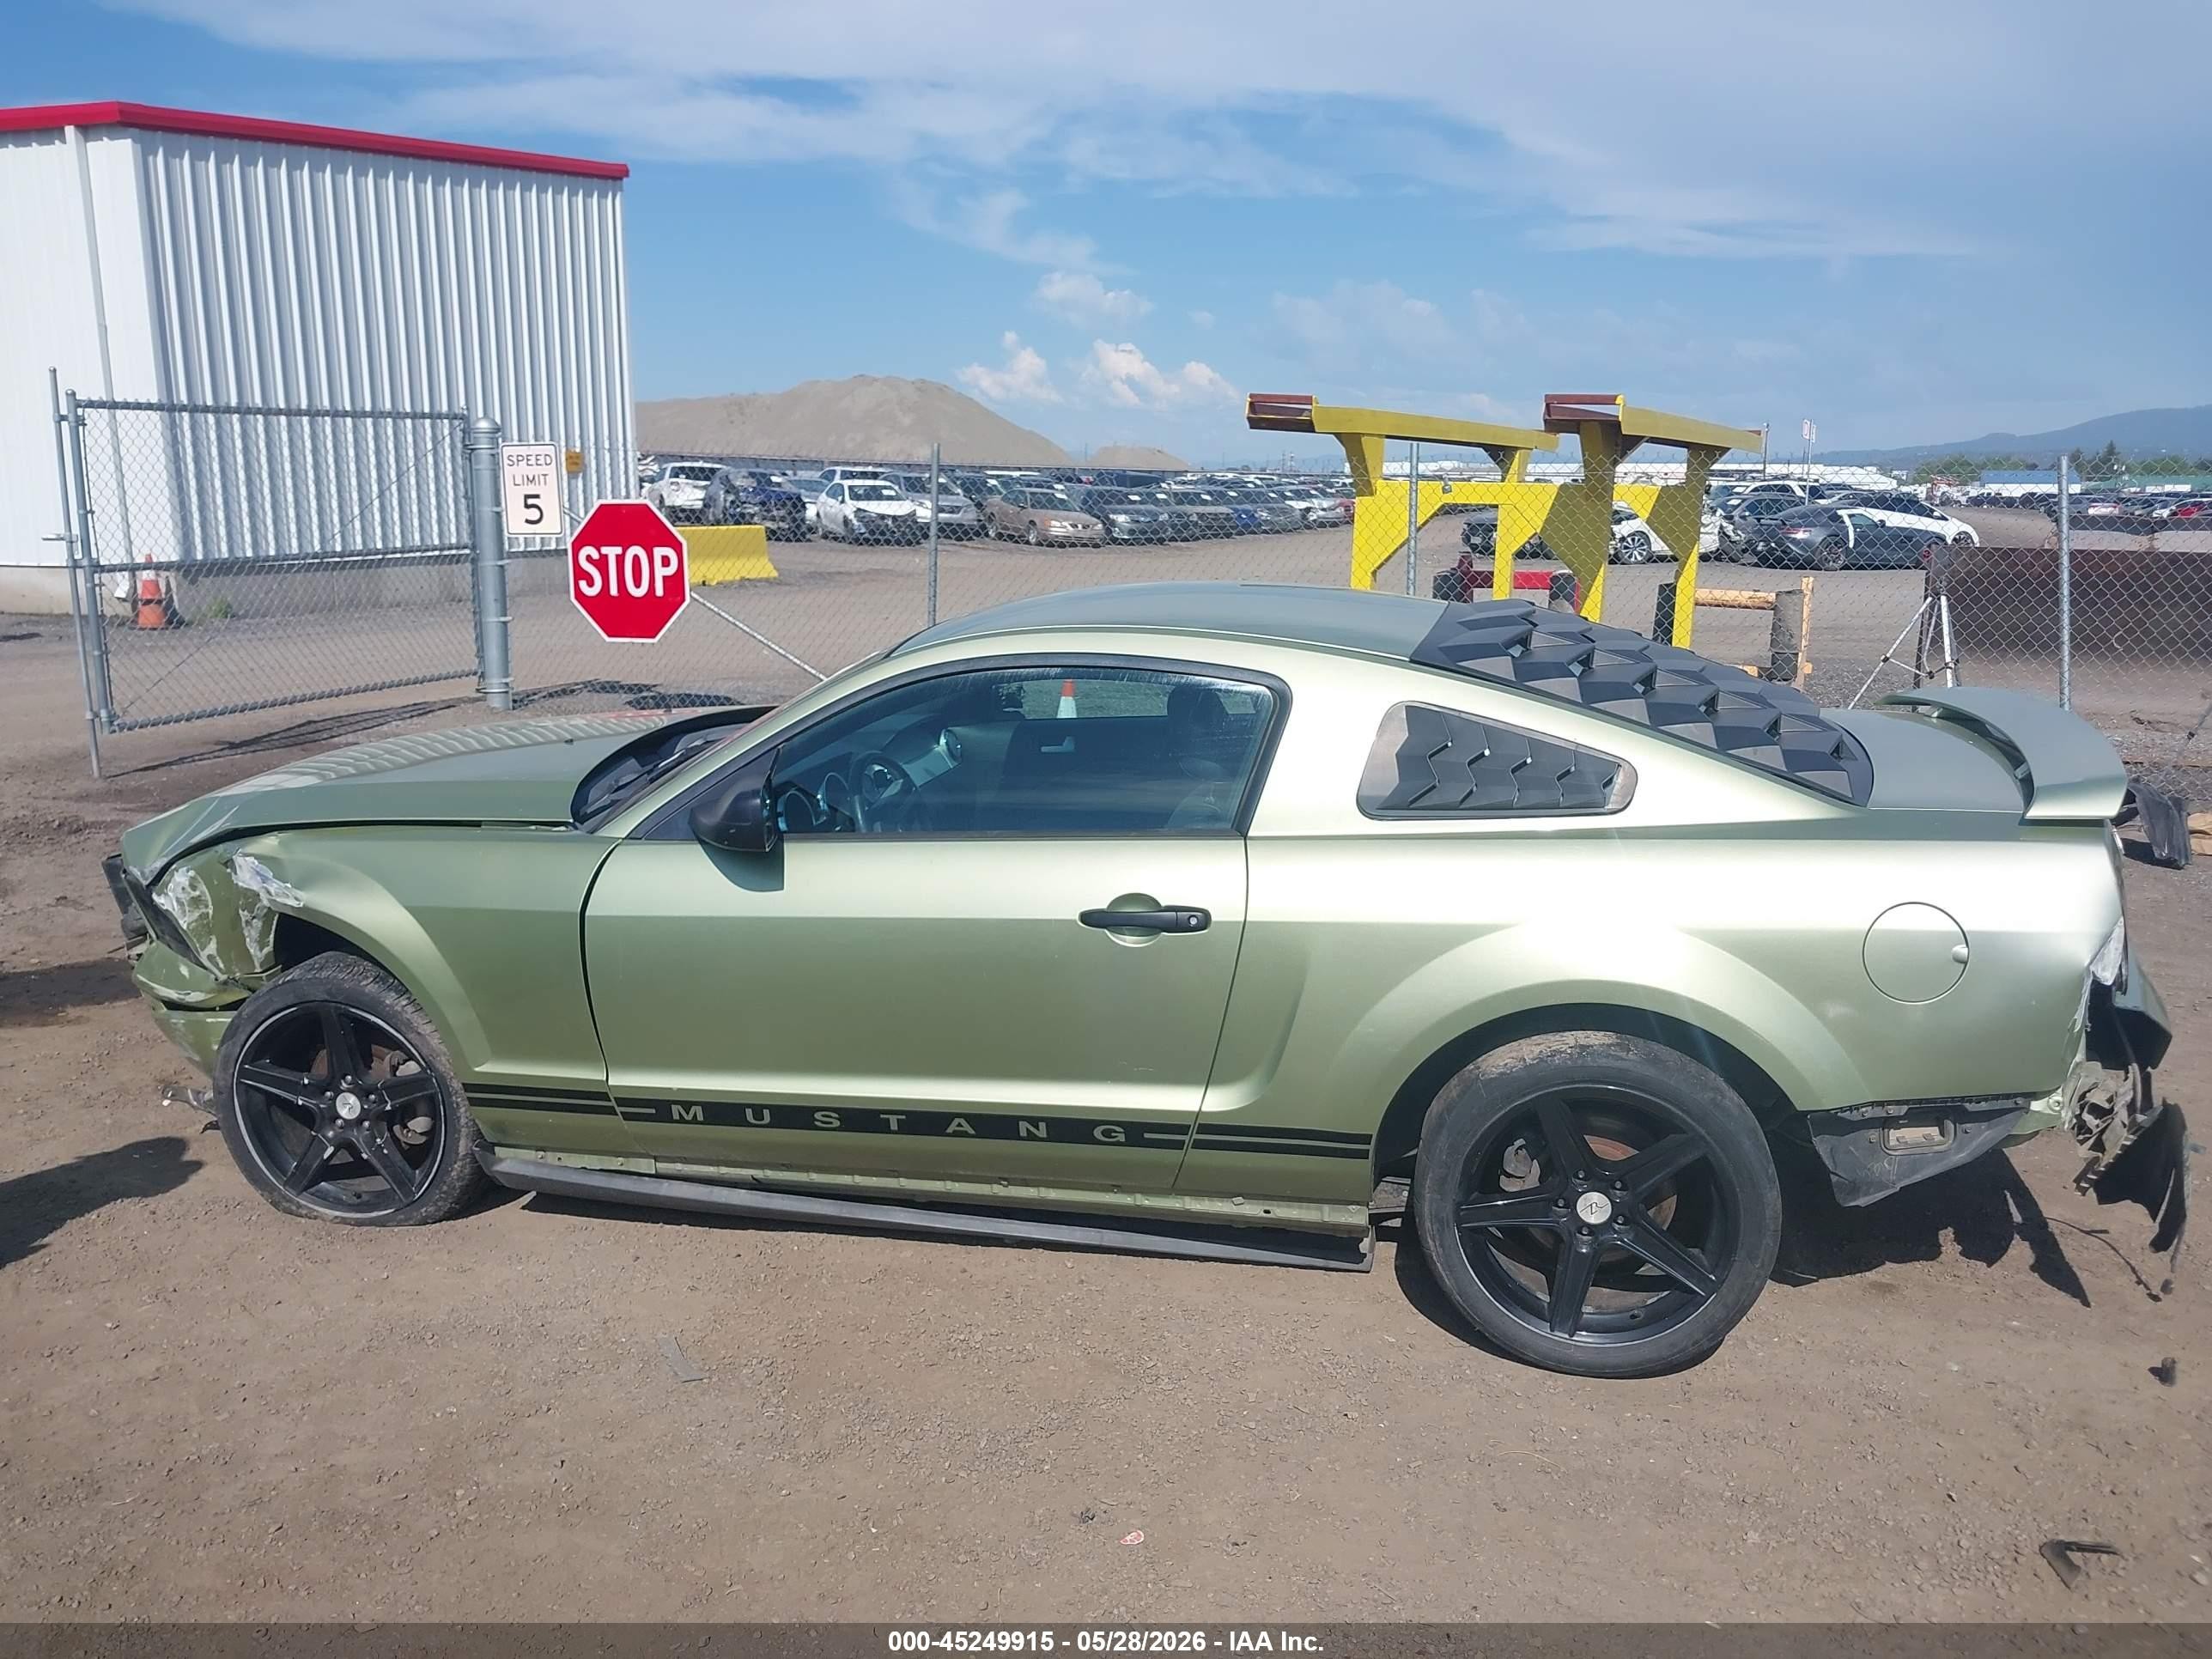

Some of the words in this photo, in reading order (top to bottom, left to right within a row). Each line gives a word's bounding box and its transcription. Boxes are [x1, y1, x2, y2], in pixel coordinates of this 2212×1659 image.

[507, 453, 553, 467] SPEED
[513, 473, 550, 487] LIMIT
[523, 494, 544, 526] 5
[577, 544, 679, 598] STOP
[671, 1103, 1127, 1143] MUSTANG
